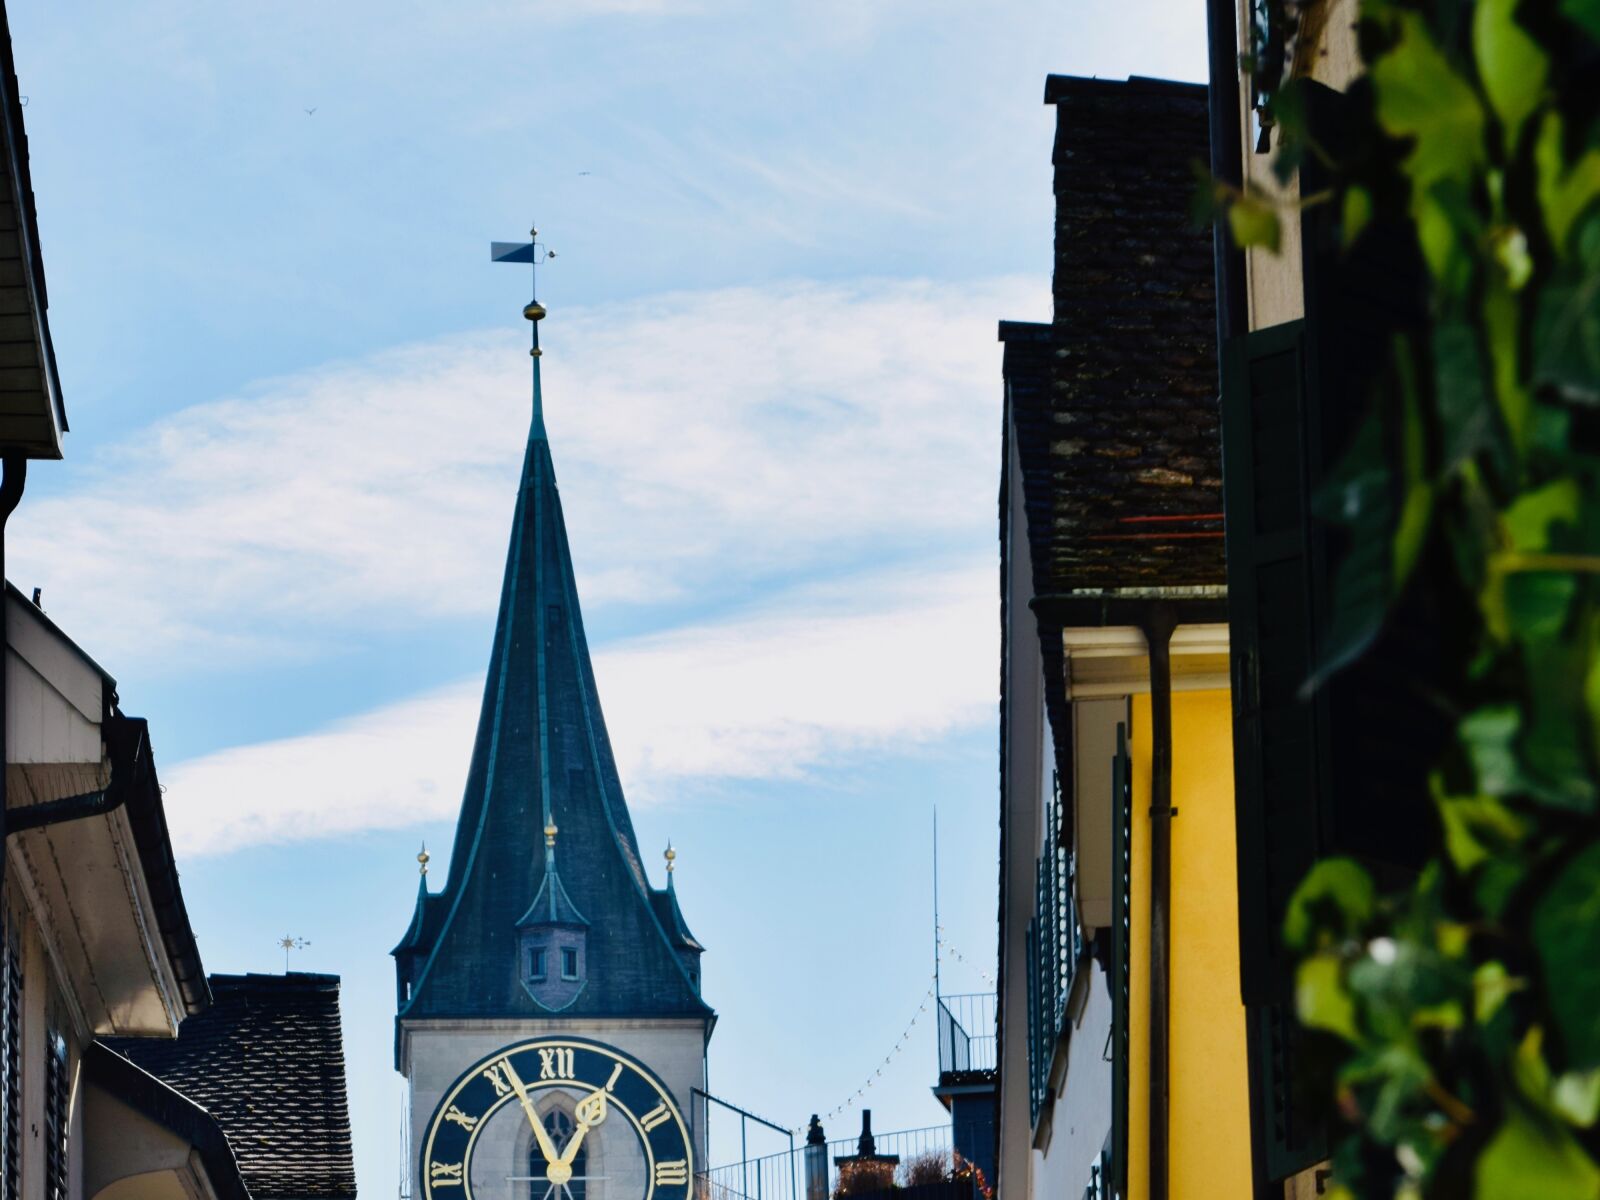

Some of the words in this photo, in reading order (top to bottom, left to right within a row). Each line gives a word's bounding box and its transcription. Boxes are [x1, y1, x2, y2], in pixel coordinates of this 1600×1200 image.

[538, 1047, 574, 1080] XII
[605, 1062, 623, 1092] I
[445, 1104, 478, 1131] X
[640, 1102, 671, 1132] II
[655, 1158, 687, 1187] III
